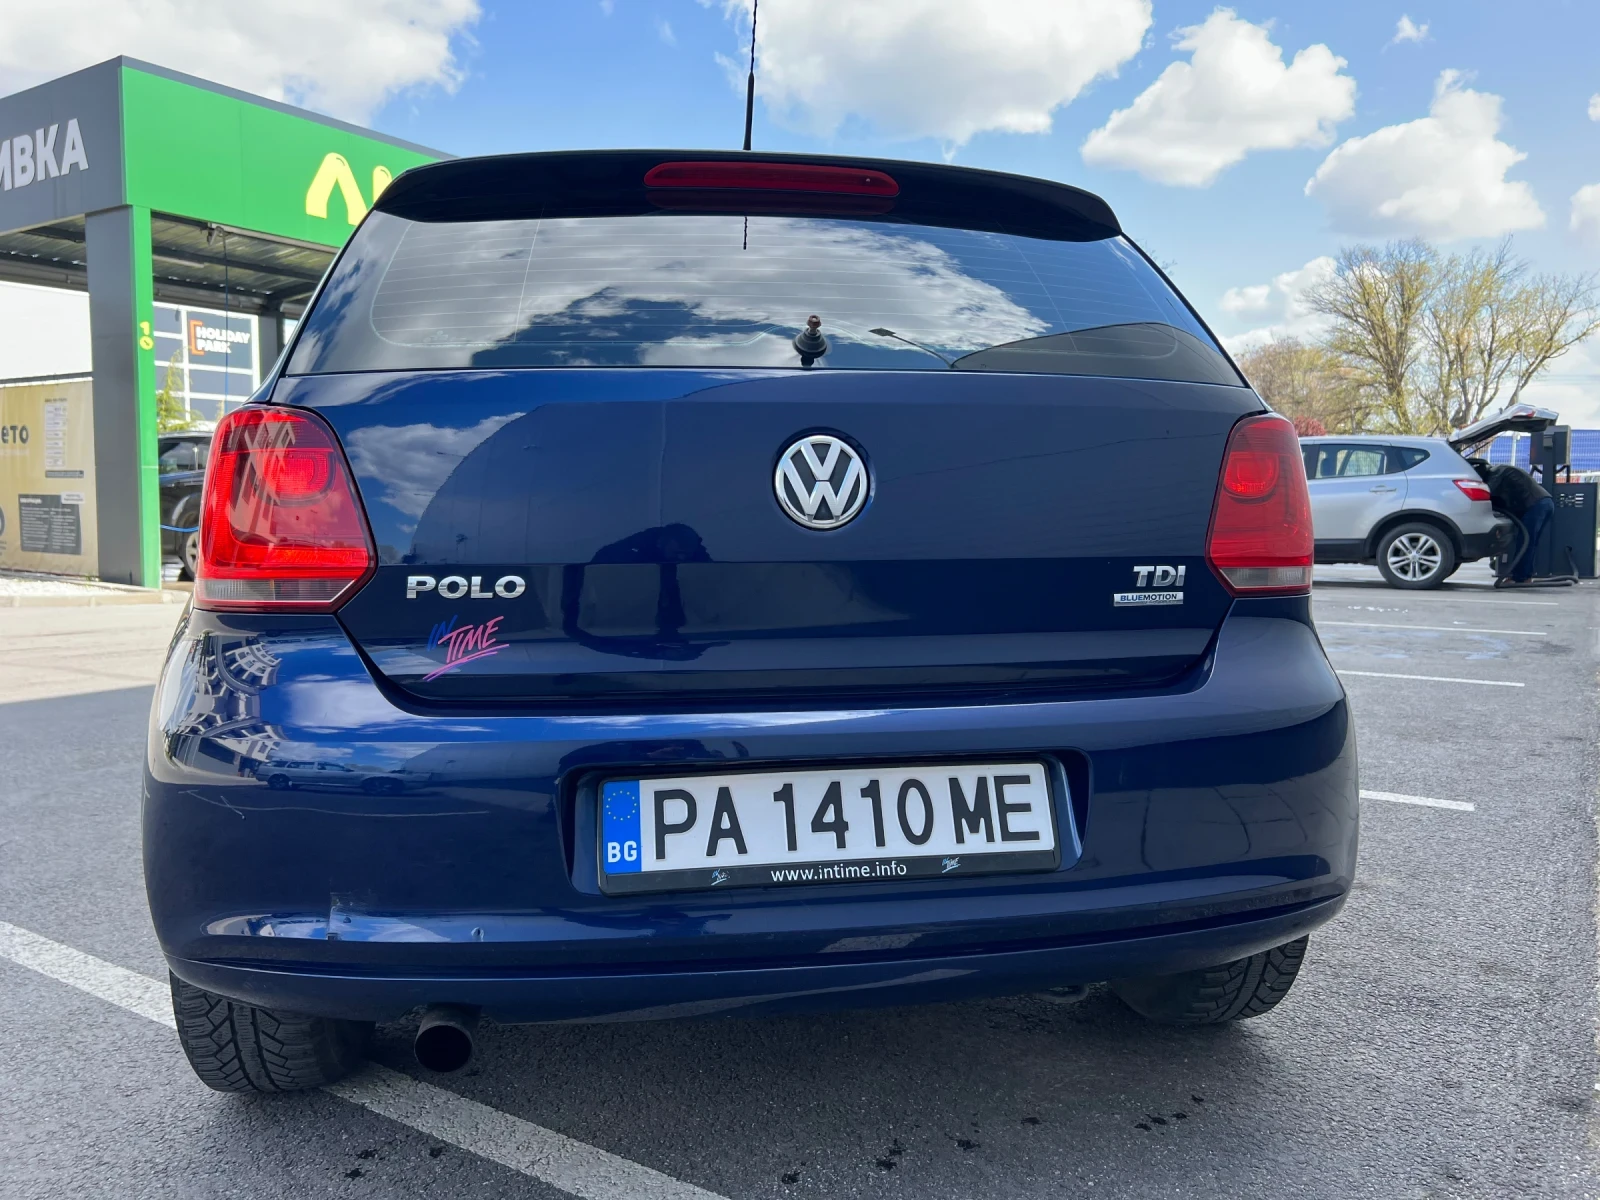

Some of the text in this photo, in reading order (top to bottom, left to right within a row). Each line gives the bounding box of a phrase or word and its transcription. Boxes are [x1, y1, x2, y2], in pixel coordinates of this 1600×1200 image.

[195, 326, 250, 344] HOLIDAY
[197, 338, 232, 354] PARK
[406, 575, 526, 599] POLO
[1133, 565, 1186, 587] TDI
[1120, 593, 1178, 602] BLUEMOTION
[426, 614, 458, 652] IN
[437, 615, 504, 663] TIME
[653, 774, 1040, 860] PA 1410 ME
[607, 840, 637, 863] BG
[770, 860, 907, 882] www.intime.info
